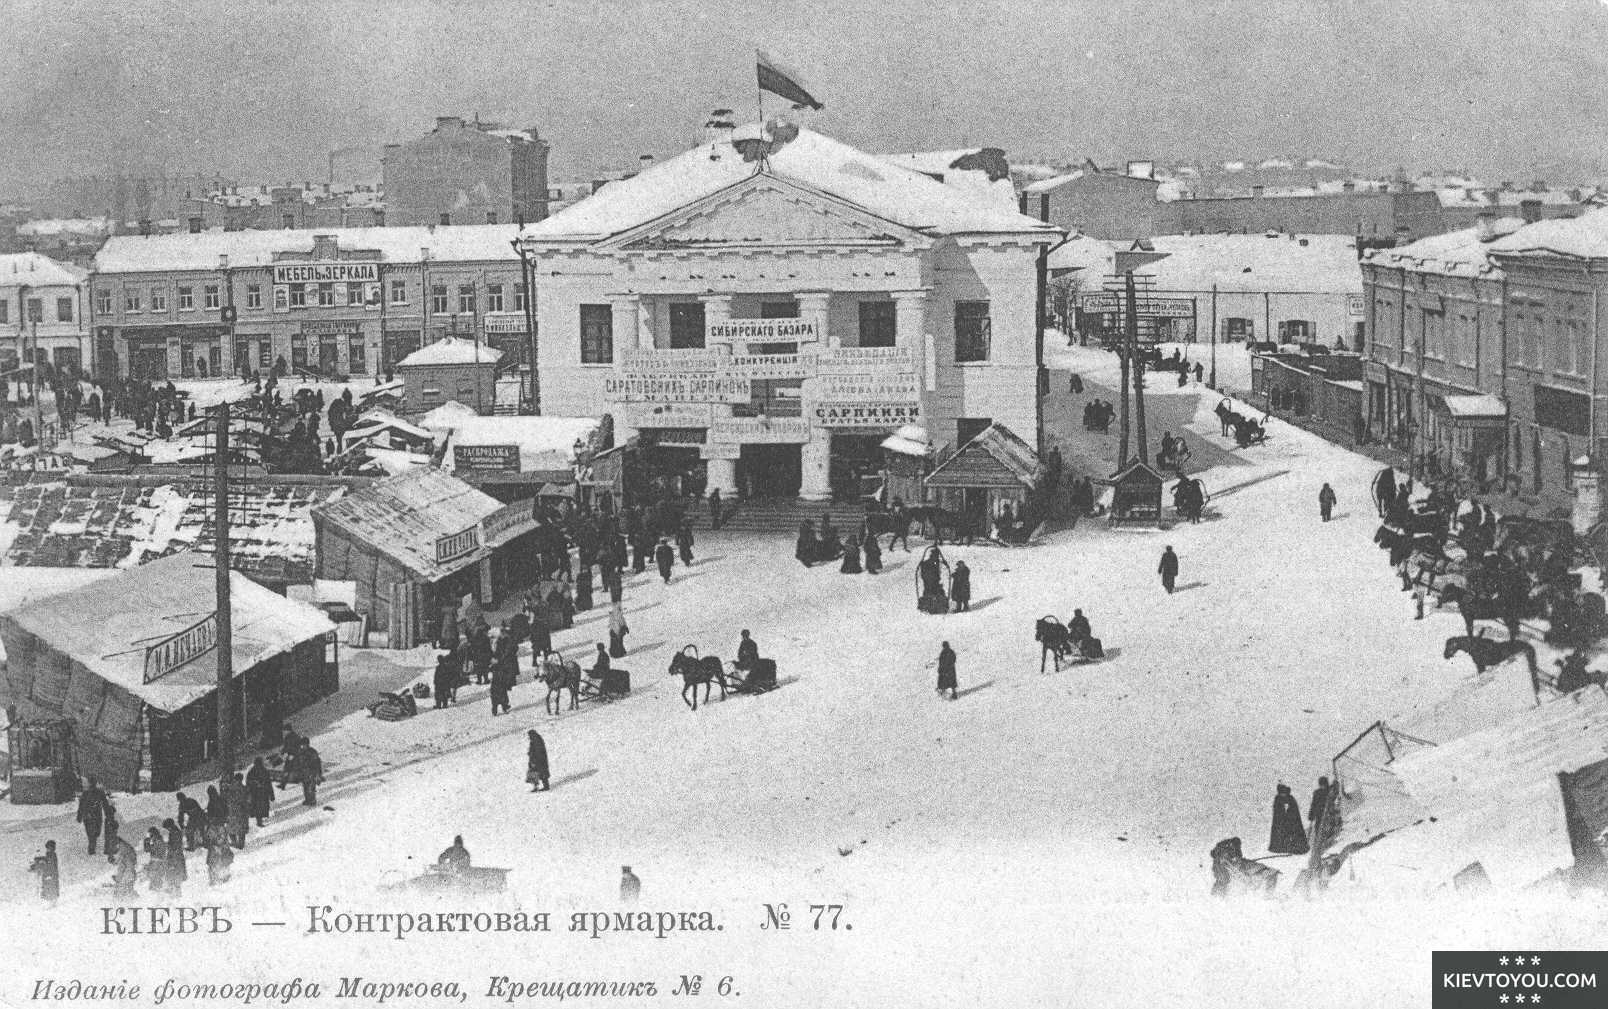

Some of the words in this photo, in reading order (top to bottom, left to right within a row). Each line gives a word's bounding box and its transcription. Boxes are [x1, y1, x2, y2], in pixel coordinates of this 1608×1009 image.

[278, 267, 322, 281] МЕБЕЛЬ
[326, 265, 376, 280] ЗЕРКАЛА
[711, 326, 774, 337] СИБИРСКАГО
[778, 324, 813, 336] БАЗАРА
[606, 379, 685, 394] САРАТОВСКИХЪ
[816, 407, 919, 418] САРПИНКИ
[463, 447, 509, 457] РАСПРОДАЖА
